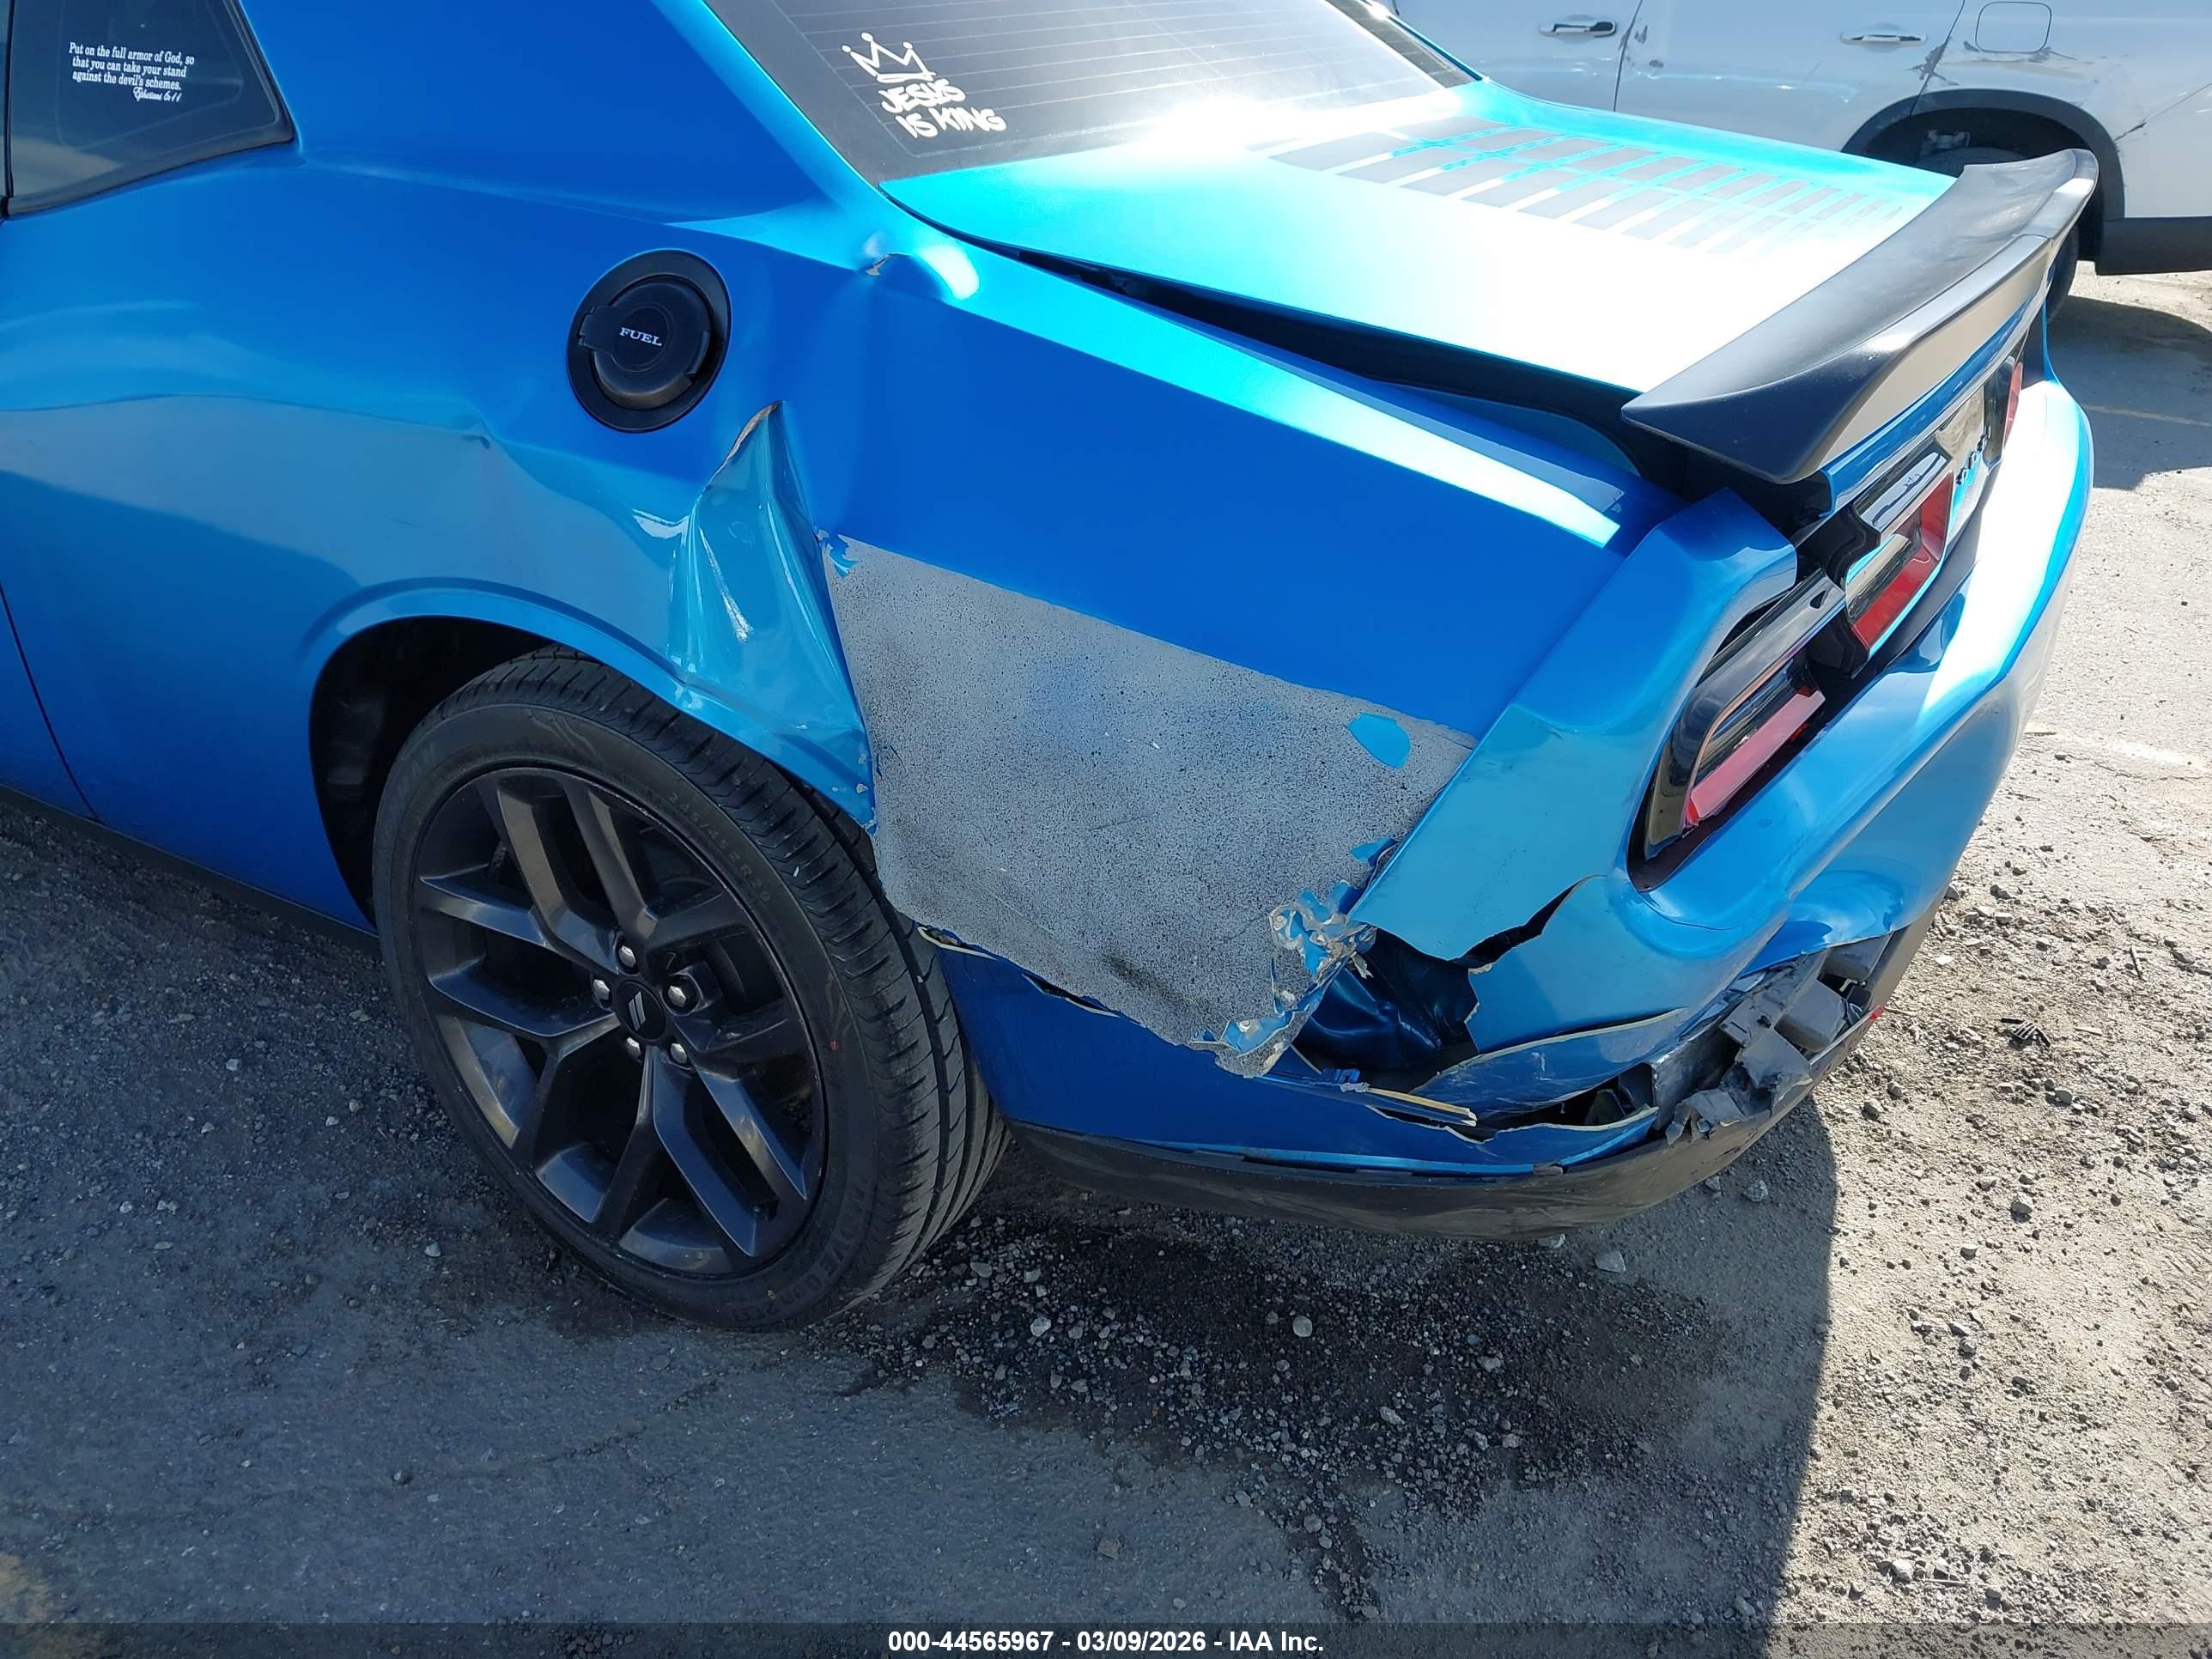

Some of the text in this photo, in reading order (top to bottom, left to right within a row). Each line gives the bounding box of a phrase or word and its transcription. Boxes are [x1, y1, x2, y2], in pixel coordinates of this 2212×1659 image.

[69, 42, 83, 53] Put
[97, 45, 110, 57] the
[112, 46, 126, 59] full
[128, 51, 152, 61] armor
[155, 51, 165, 63] of
[165, 52, 183, 66] God,
[185, 56, 194, 65] so
[72, 56, 186, 77] that you can take your stand
[72, 70, 181, 90] against the devil's schemes.
[878, 78, 967, 112] JESUS
[895, 106, 1006, 138] IS KING
[619, 327, 662, 346] FUEL
